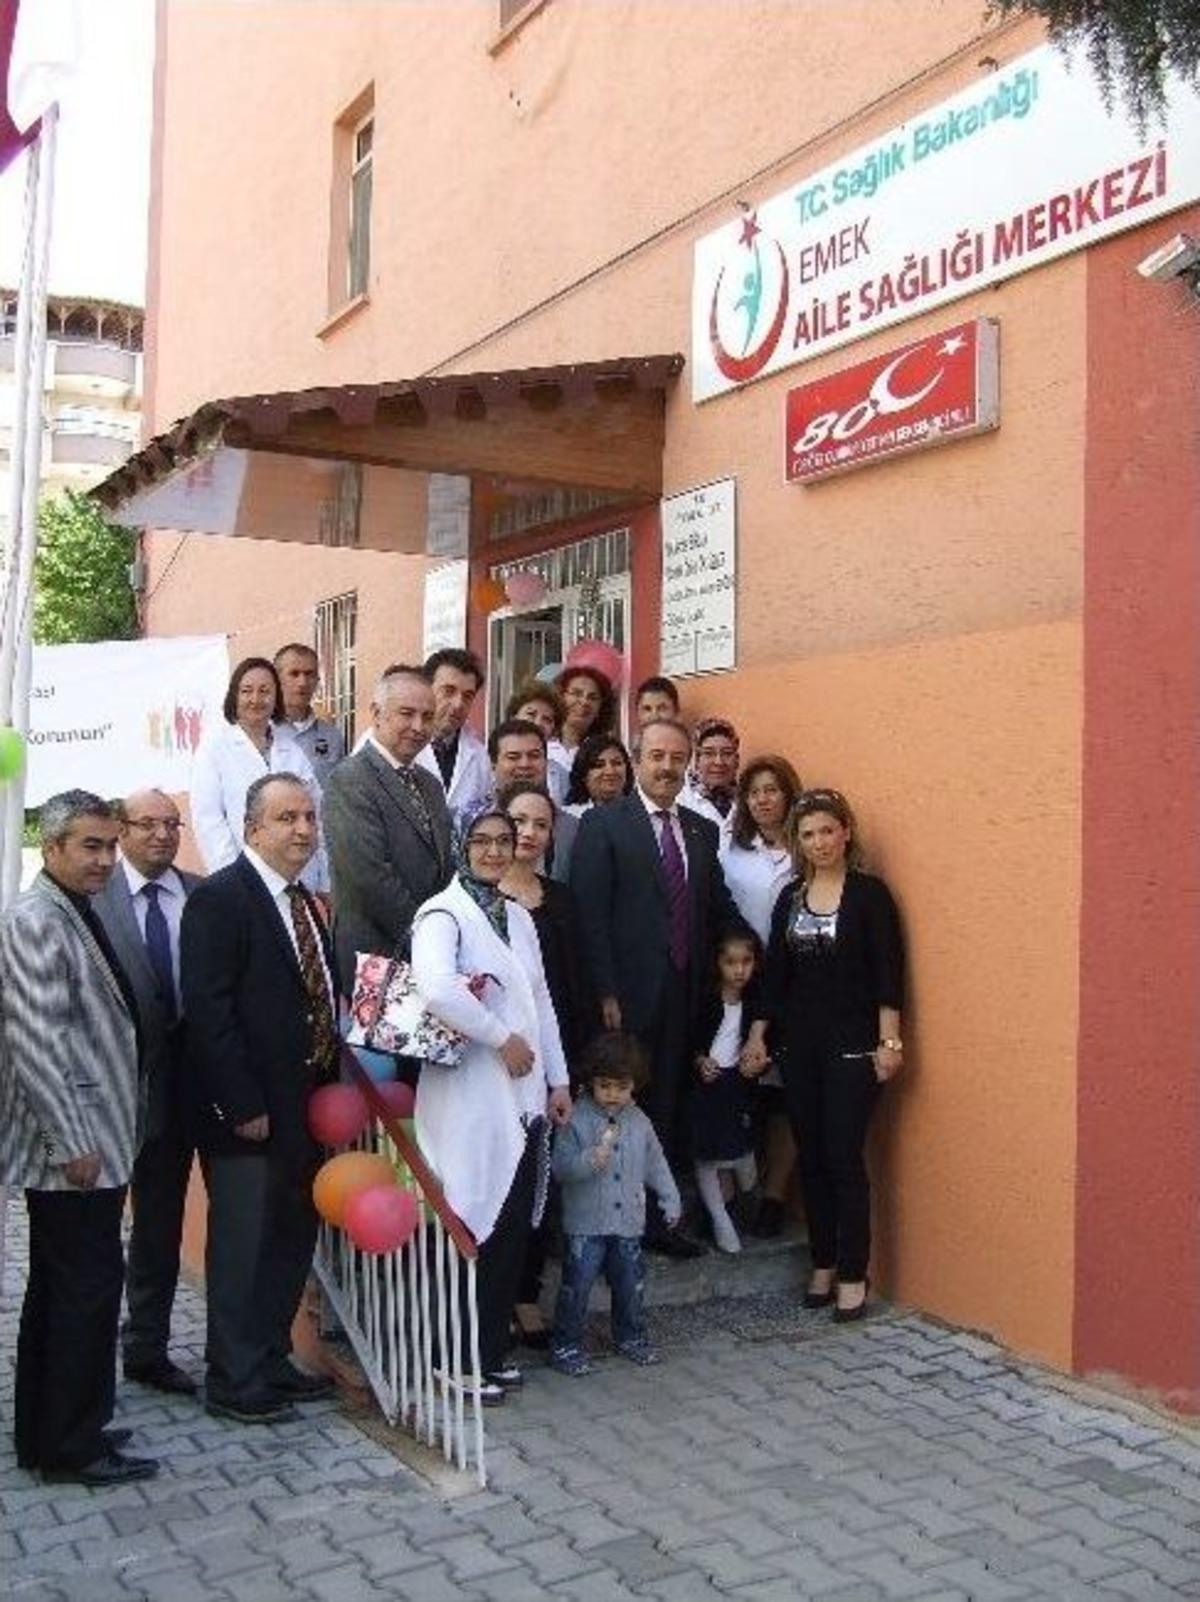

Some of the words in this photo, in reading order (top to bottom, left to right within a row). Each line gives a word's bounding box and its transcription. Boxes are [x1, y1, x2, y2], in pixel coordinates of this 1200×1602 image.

[832, 142, 905, 204] Sağlık
[913, 69, 1039, 163] Bakanlığı
[793, 290, 851, 350] AİLE
[858, 228, 984, 321] SAĞLIĞI
[993, 140, 1167, 266] MERKEZİ
[800, 216, 870, 284] EMEK
